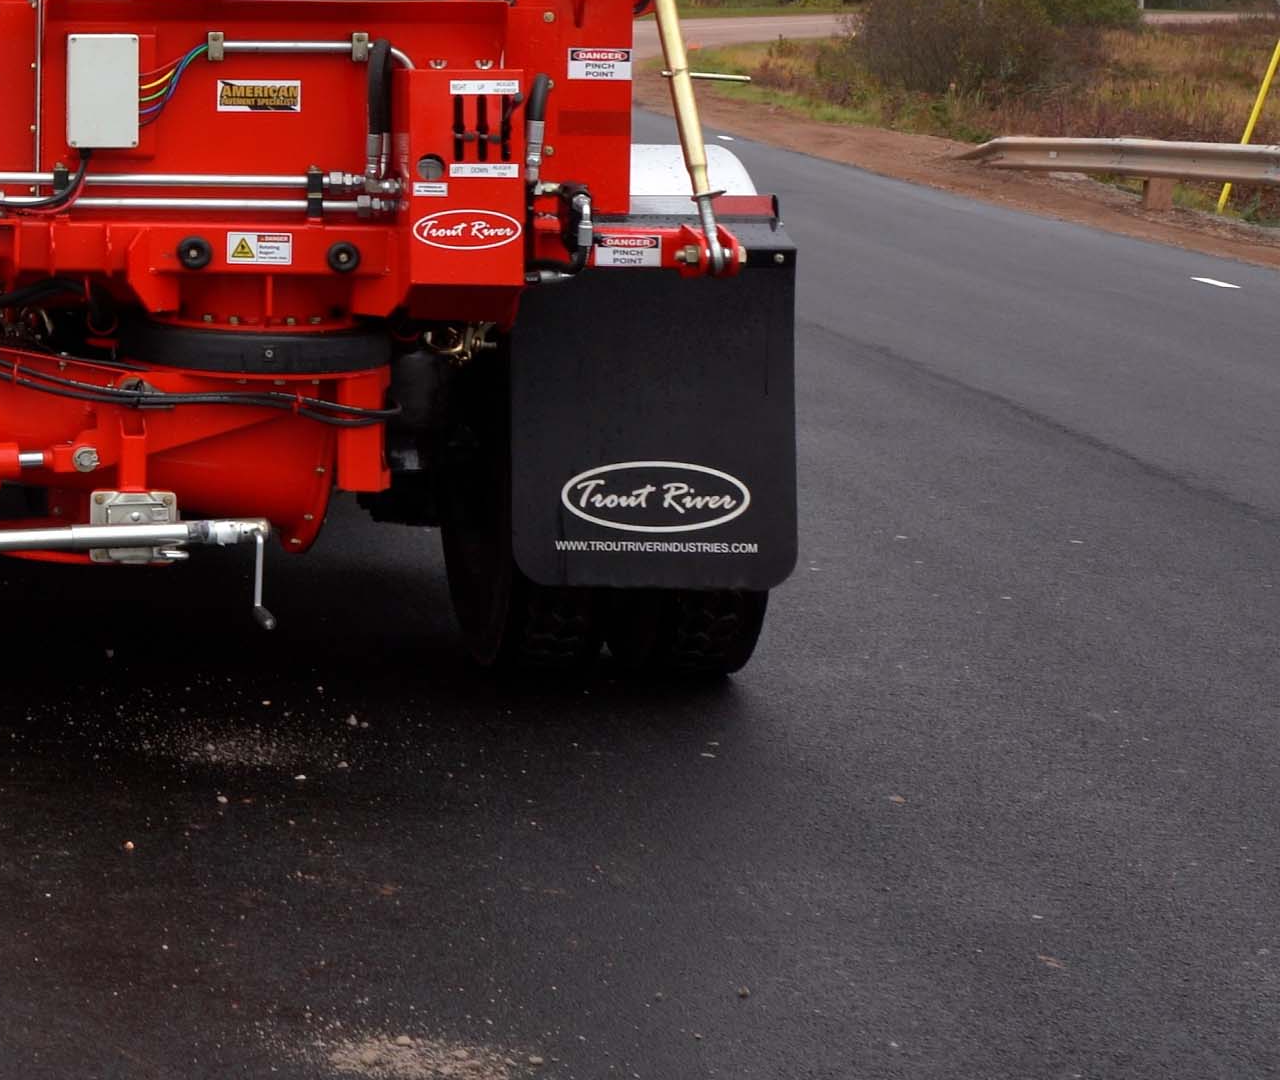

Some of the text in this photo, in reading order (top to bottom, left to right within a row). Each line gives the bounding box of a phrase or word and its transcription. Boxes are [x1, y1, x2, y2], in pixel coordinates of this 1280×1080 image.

[579, 52, 622, 60] DANGER
[222, 85, 298, 97] AMERICAN
[421, 220, 514, 239] Trout River
[607, 238, 650, 246] DANGER
[577, 479, 736, 514] Trout River
[555, 540, 758, 553] WWW.TROUTRIVERINDUSTRIES.COM
